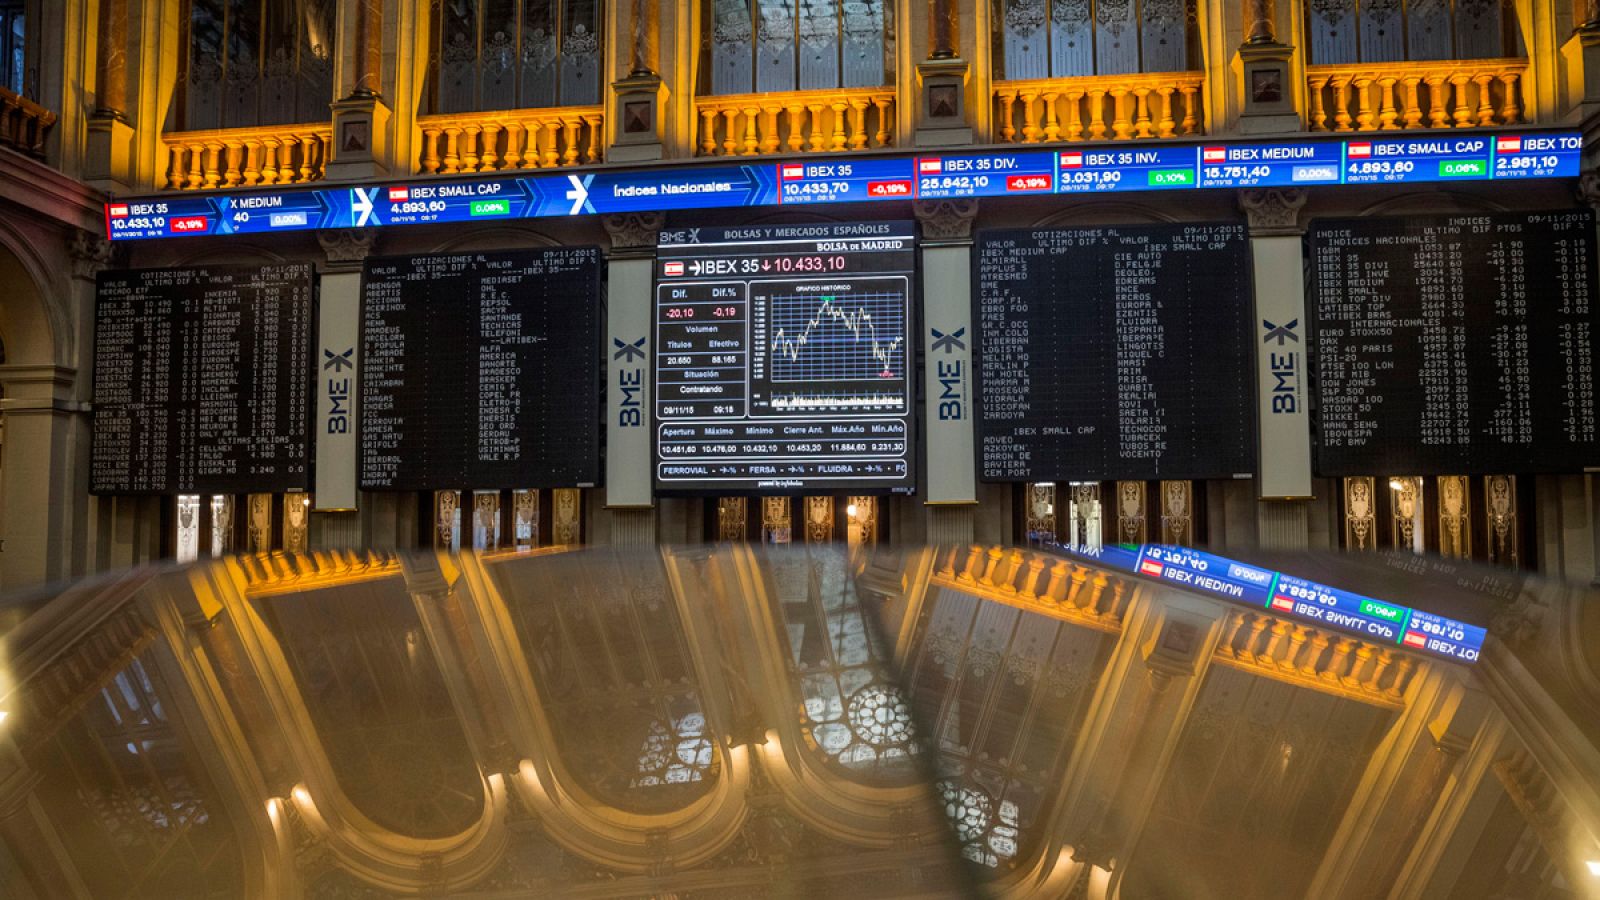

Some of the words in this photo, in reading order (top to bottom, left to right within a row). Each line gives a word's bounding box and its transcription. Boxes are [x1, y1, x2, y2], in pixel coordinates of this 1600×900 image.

[1374, 144, 1404, 156] IBEX
[1408, 143, 1452, 154] SMALL
[1455, 141, 1484, 153] CAP
[1524, 139, 1555, 150] IBEX
[1085, 154, 1115, 165] IBEX
[1118, 153, 1133, 164] 35
[1136, 152, 1160, 164] INV.
[1229, 149, 1258, 160] IBEX
[1262, 147, 1314, 159] MEDIUM
[944, 160, 973, 171] IBEX
[976, 159, 991, 170] 35
[994, 158, 1018, 169] DIV.
[1348, 161, 1413, 174] 4.893,60
[1497, 156, 1557, 169] 2.981,10
[806, 166, 835, 177] IBEX
[838, 165, 852, 176] 35
[1204, 166, 1270, 178] 15.751,40
[1299, 169, 1332, 178] 0,00%
[920, 176, 988, 189] 25.642,10
[1061, 171, 1120, 184] 3.031,90
[1156, 173, 1185, 183] 0,10%
[411, 187, 436, 198] IBEX
[439, 185, 475, 197] SMALL
[478, 184, 500, 195] CAP
[614, 184, 657, 197] Índices
[660, 182, 731, 194] Nacionales
[784, 183, 848, 195] 10.433,70
[239, 197, 282, 208] MEDIUM
[391, 201, 445, 214] 4.893,60
[130, 203, 154, 215] IBEX
[156, 203, 168, 214] 35
[112, 217, 164, 230] 10.433,10
[233, 212, 248, 223] 40
[1448, 217, 1491, 226] INDICES
[1527, 214, 1591, 223] 09/11/2015
[660, 231, 685, 242] BME
[724, 229, 761, 240] BOLSAS
[765, 229, 771, 238] Y
[775, 226, 829, 238] MERCADOS
[833, 224, 890, 235] ESPAÑOLES
[1032, 230, 1102, 239] COTIZACIONES
[1108, 229, 1120, 237] AL
[1184, 225, 1244, 234] 09/11/2015
[1316, 230, 1352, 238] INDICE
[1423, 227, 1461, 235] ULTIMO
[1497, 225, 1523, 233] PTOS
[816, 242, 848, 252] BOLSA
[860, 240, 903, 250] MADRID
[986, 240, 1015, 248] VALOR
[1038, 239, 1073, 247] ULTIMO
[1328, 237, 1370, 246] INDICES
[1375, 236, 1437, 245] NACIONALES
[1009, 247, 1044, 256] MEDIUM
[701, 260, 737, 273] IBEX
[740, 259, 759, 272] 35
[774, 256, 845, 272] 10.433,10
[981, 256, 1027, 264] ALMIRALL
[1317, 255, 1341, 263] IBEX
[1347, 254, 1359, 262] 35
[672, 290, 688, 298] Dif.
[712, 288, 736, 297] Dif.%
[713, 307, 736, 317] -0,19
[1350, 318, 1441, 328] INTERNACIONALES
[1344, 345, 1357, 353] 40
[1362, 344, 1393, 353] PARIS
[684, 370, 719, 378] Situación
[1271, 352, 1295, 413] BME
[1346, 378, 1376, 386] JONES
[680, 385, 723, 393] Contratando
[938, 360, 960, 420] BME
[620, 369, 640, 426] BME
[328, 379, 347, 433] BME
[664, 406, 694, 414] 09/11/15
[983, 403, 1030, 411] VISCOFAN
[662, 427, 695, 436] Apertura
[783, 426, 806, 434] Cierre
[808, 426, 824, 434] Ant.
[1119, 425, 1167, 433] TECNOCOM
[1119, 450, 1161, 458] VOCENTO
[663, 466, 708, 475] FERROVIAL
[749, 466, 776, 474] FERSA
[817, 465, 853, 473] FLUIDRA
